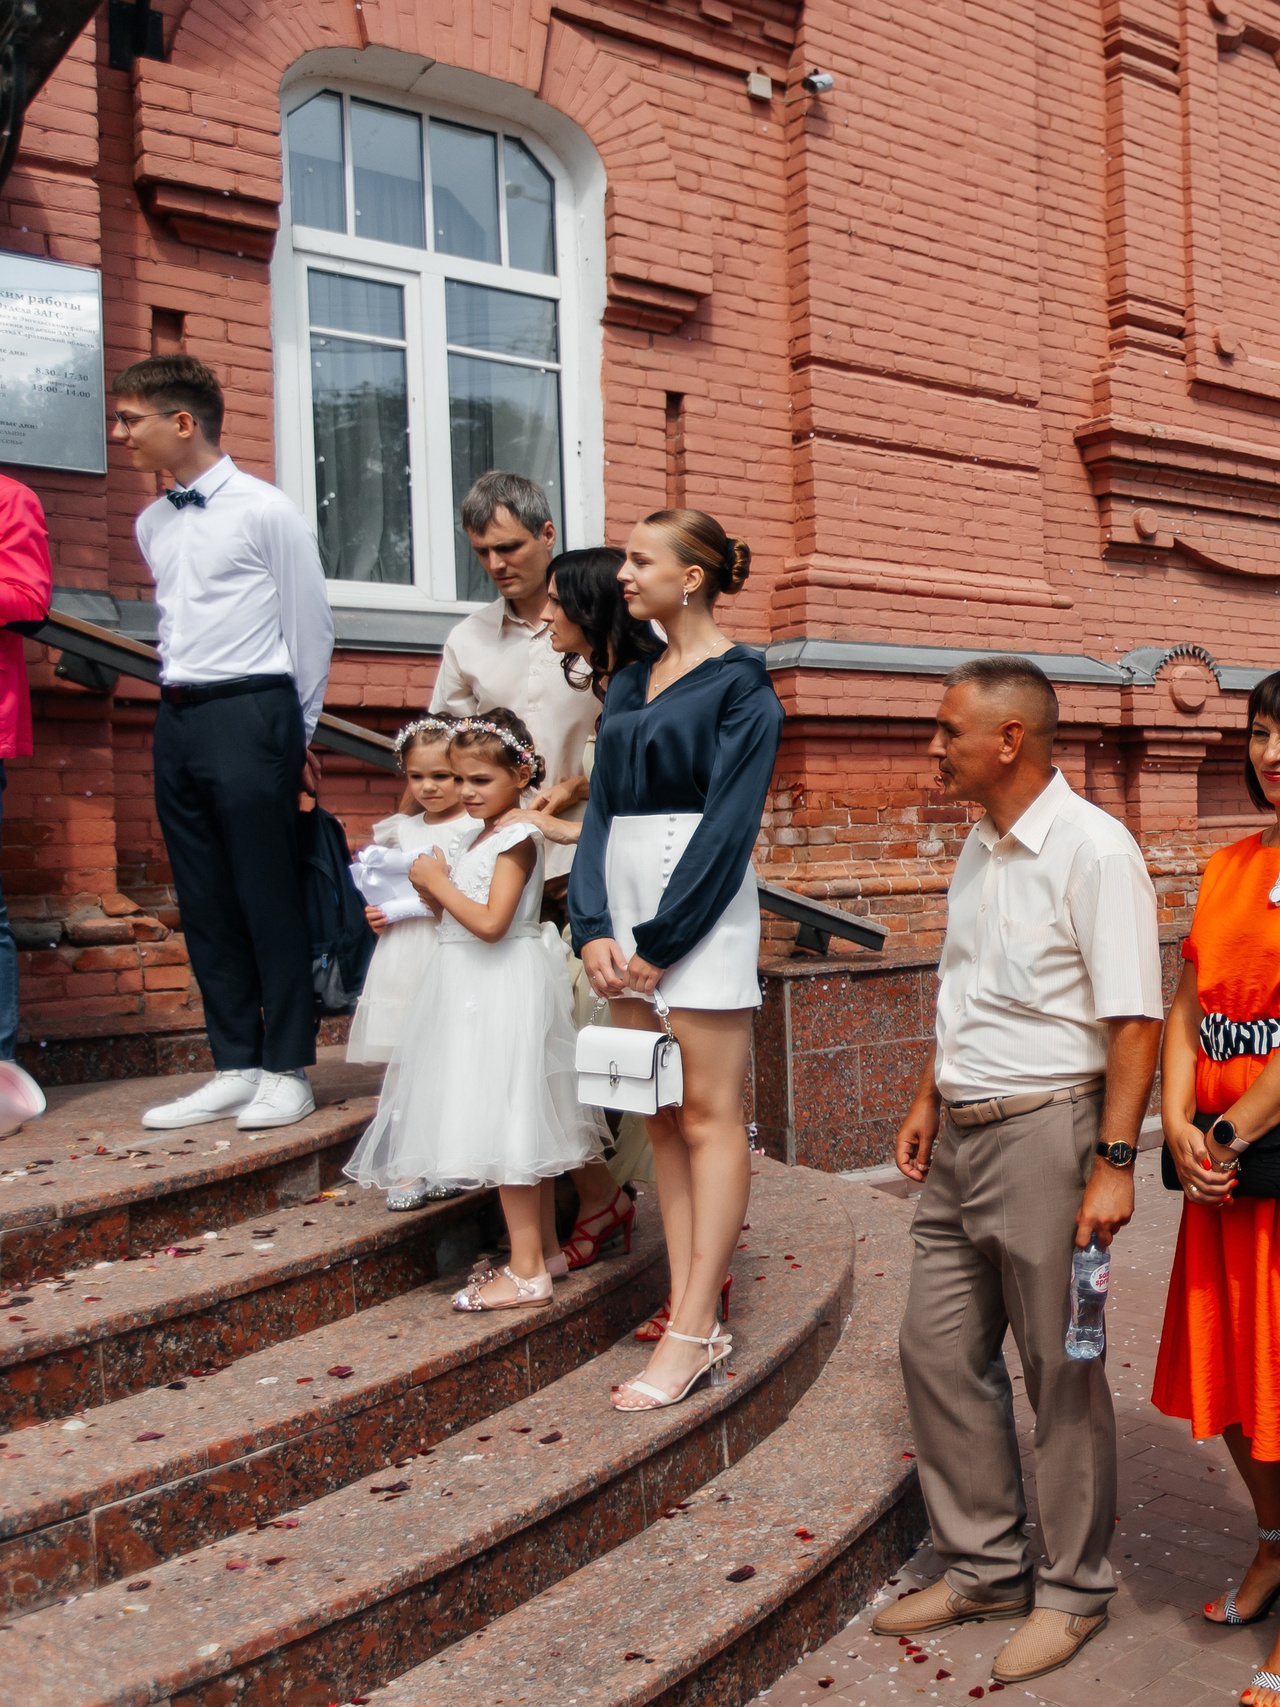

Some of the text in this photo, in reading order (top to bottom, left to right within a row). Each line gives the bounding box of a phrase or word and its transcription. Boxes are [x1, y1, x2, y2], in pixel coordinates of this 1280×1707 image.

[28, 295, 82, 312] работы
[34, 308, 64, 321] ЗАГС
[35, 367, 56, 377] 8.30
[64, 371, 90, 382] 17.30
[32, 383, 58, 394] 13.00
[66, 389, 91, 399] 14.00
